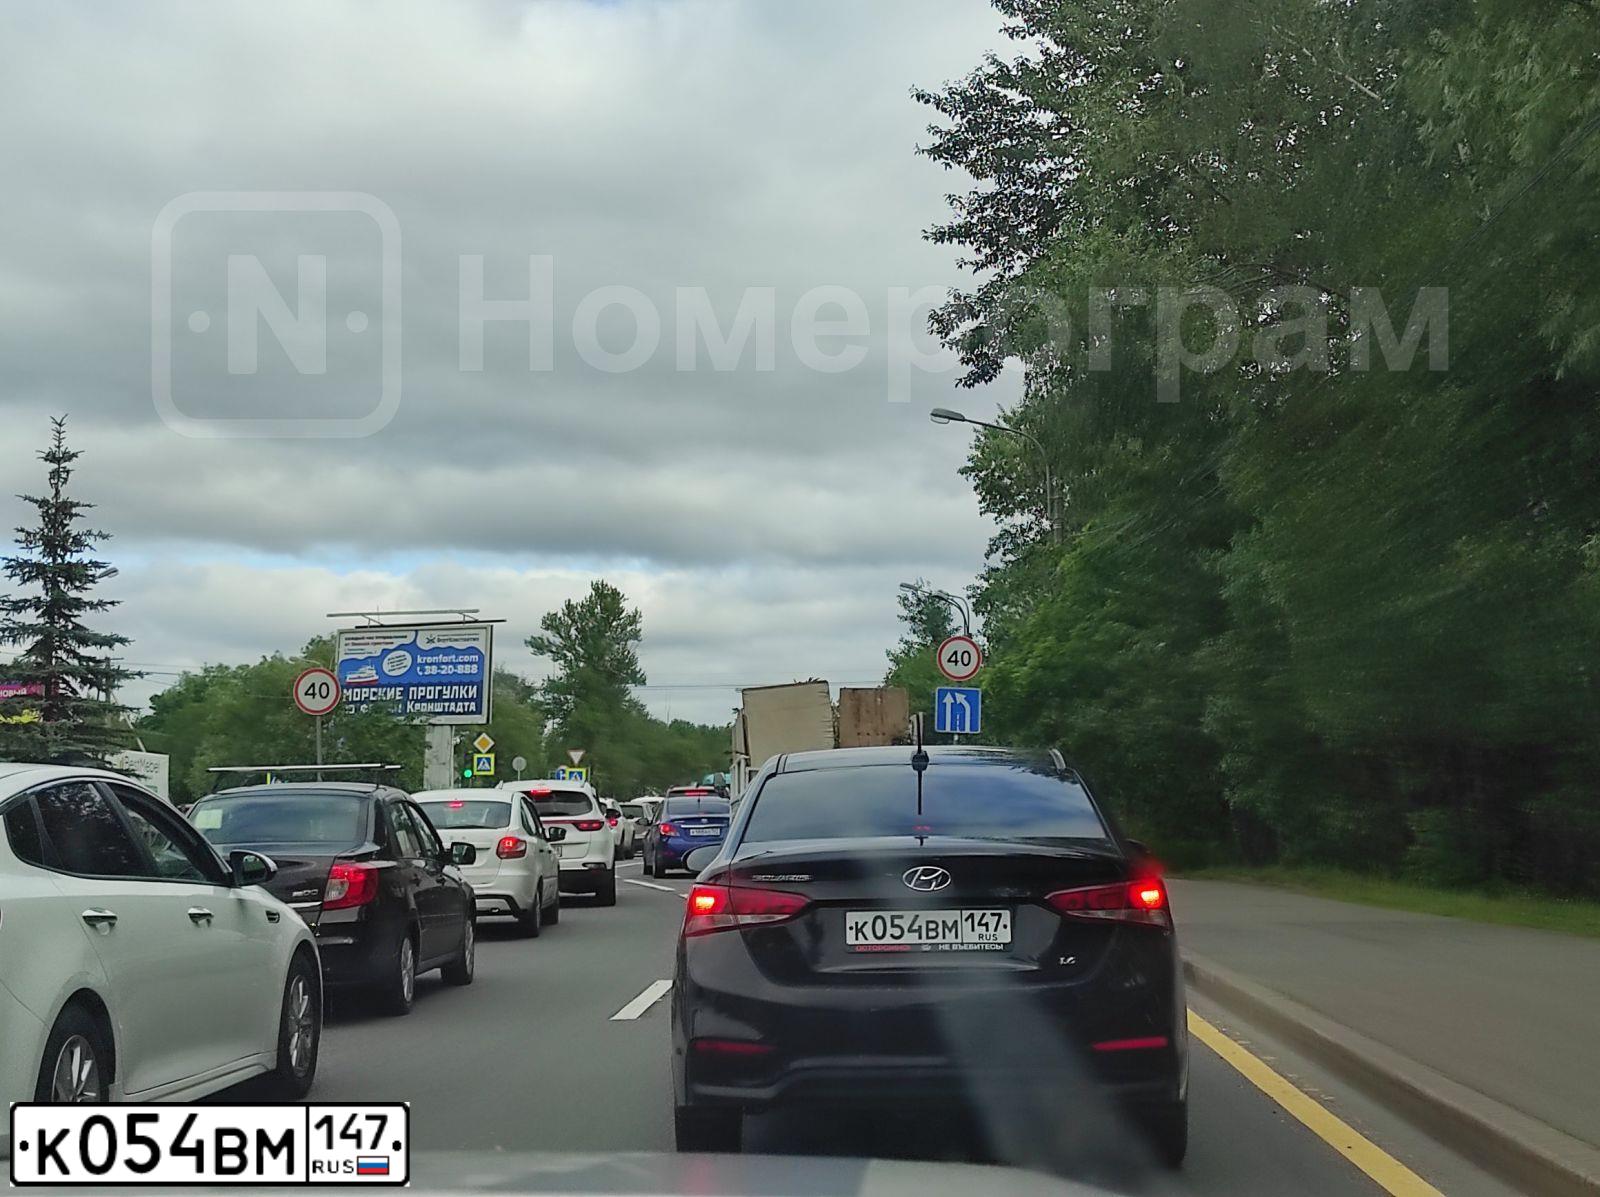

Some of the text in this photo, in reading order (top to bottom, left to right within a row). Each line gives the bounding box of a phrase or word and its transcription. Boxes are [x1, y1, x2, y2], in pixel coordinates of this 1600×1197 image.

[416, 653, 479, 664] kronfort.com
[947, 650, 972, 667] 40
[304, 682, 330, 699] 40
[343, 685, 478, 702] МОРСКИЕ ПРОГУЛКИ
[855, 912, 1003, 941] К054ВМ 147
[978, 933, 999, 942] RUS
